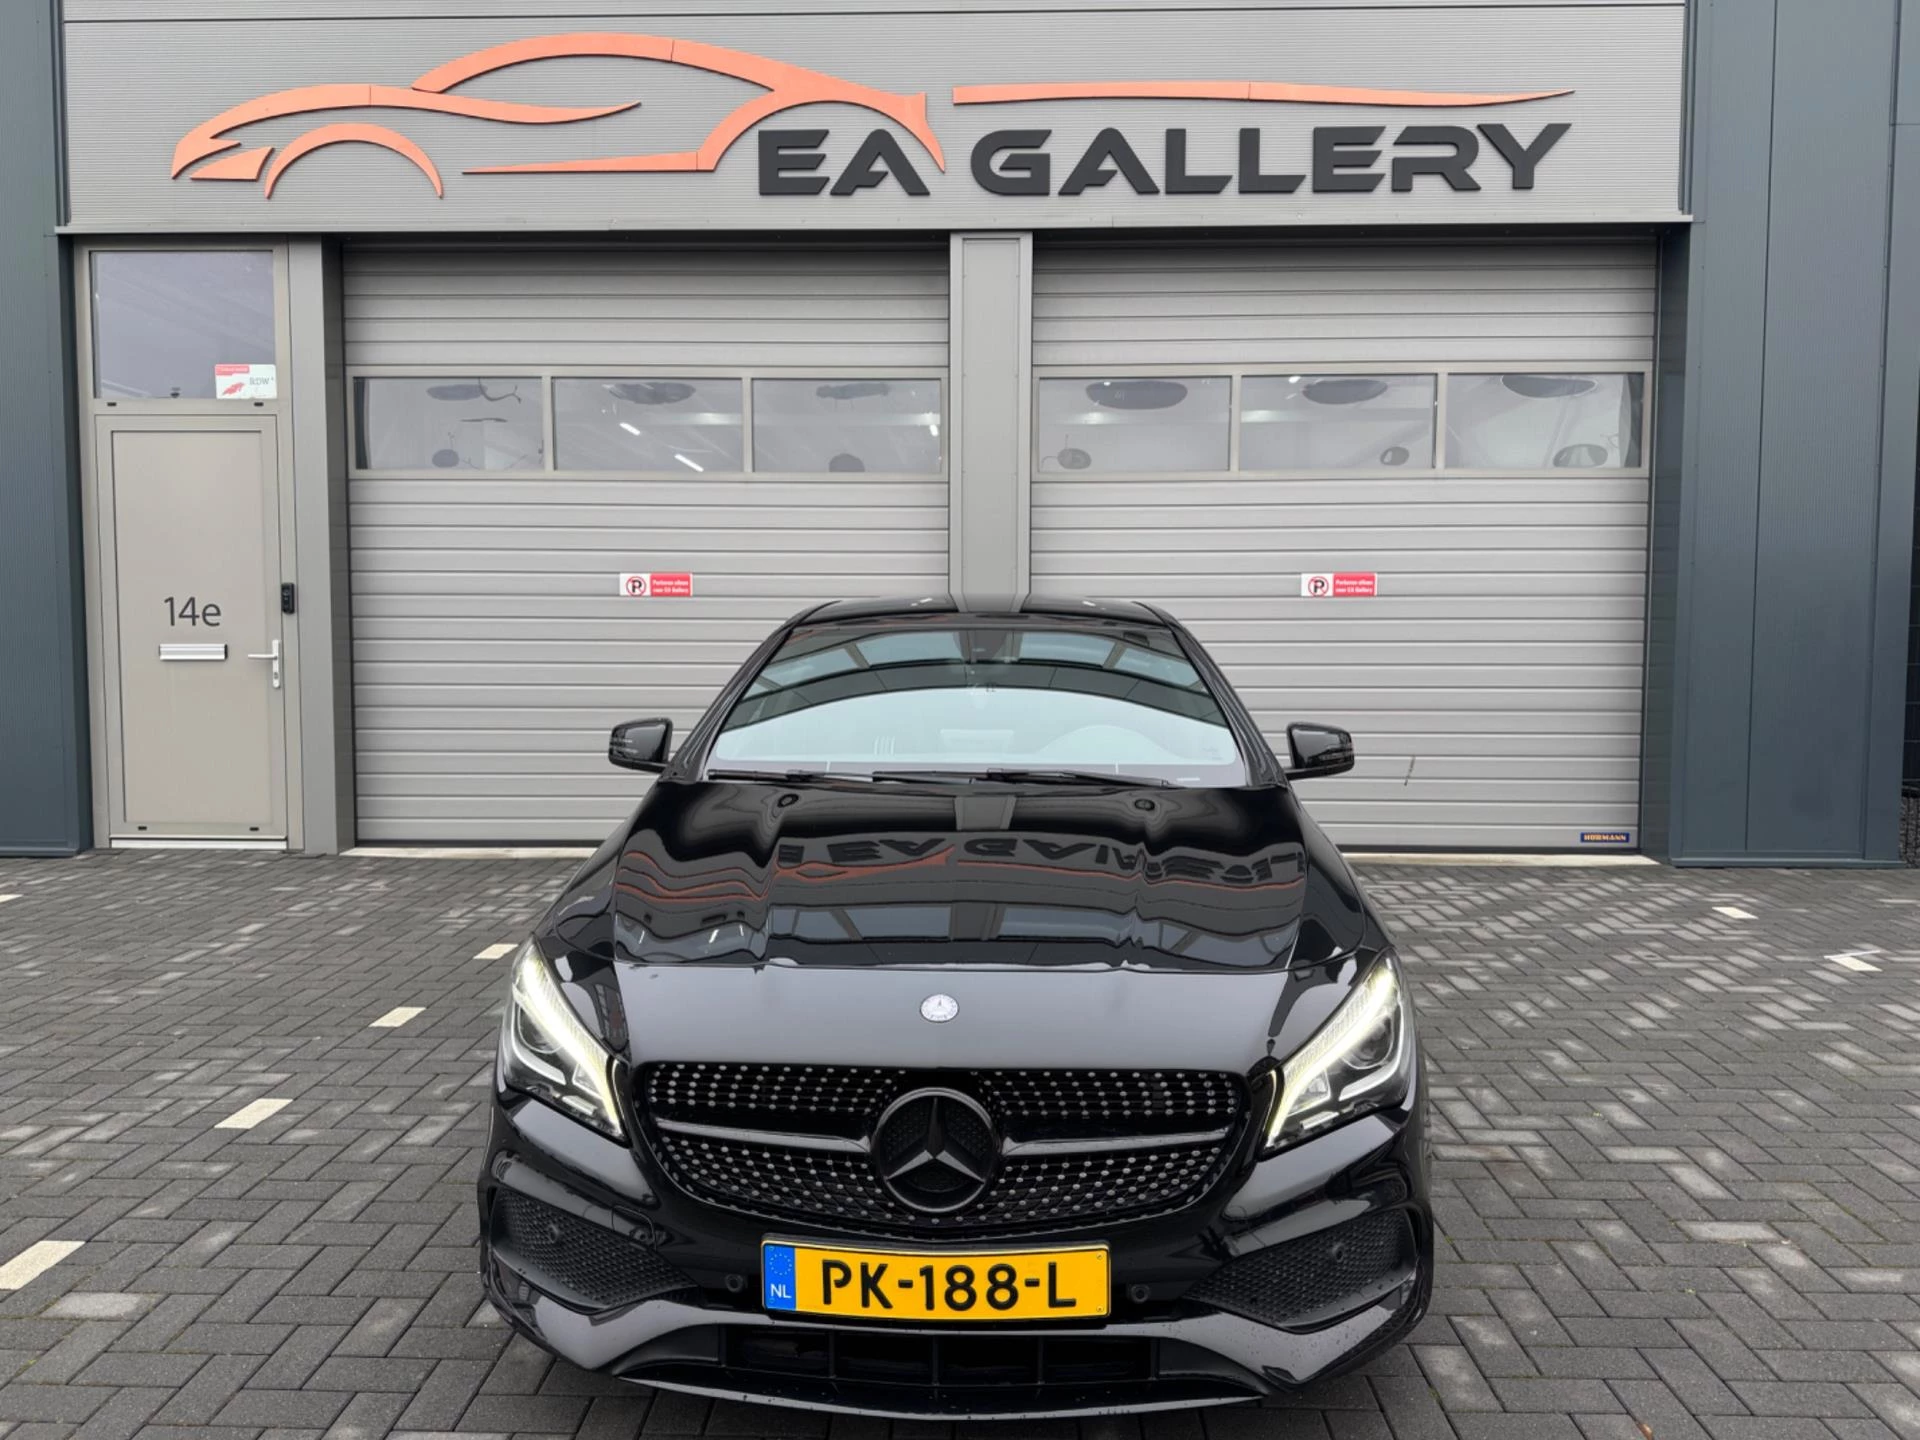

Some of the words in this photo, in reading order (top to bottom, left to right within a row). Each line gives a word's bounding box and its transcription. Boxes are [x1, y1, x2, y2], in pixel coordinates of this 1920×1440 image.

[759, 128, 931, 197] EA
[970, 122, 1572, 197] GALLERY
[164, 596, 222, 627] 14e
[770, 1283, 792, 1300] NL
[821, 1258, 1078, 1312] PK-188-L
